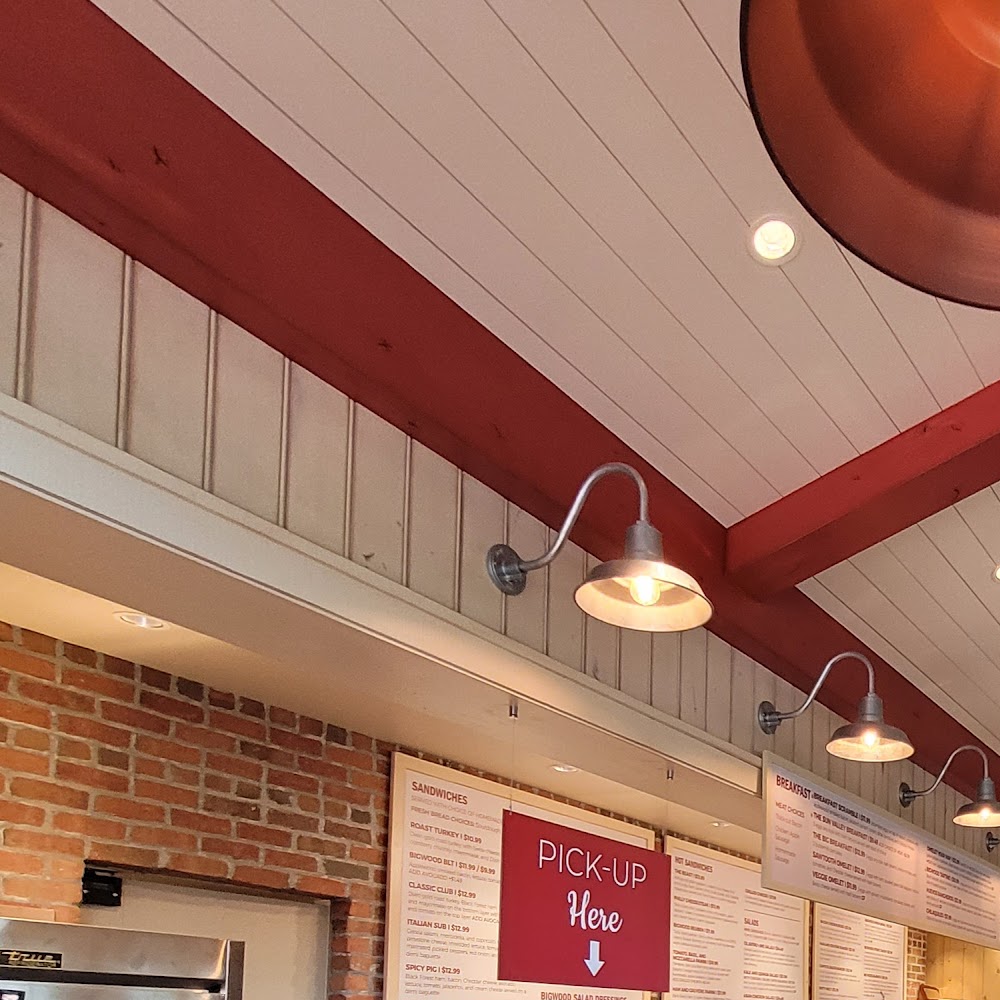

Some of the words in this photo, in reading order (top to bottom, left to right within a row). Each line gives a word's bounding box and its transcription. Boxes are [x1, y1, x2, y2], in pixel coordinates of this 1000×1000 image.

[412, 782, 467, 804] SANDWICHES
[777, 775, 811, 800] BREAKFAST
[814, 792, 838, 809] BREAKFAST
[411, 806, 429, 815] FRESH
[431, 811, 449, 820] BREAD
[410, 822, 433, 832] ROAST
[434, 827, 459, 838] TURKEY
[409, 852, 442, 863] BIGWOOD
[539, 839, 647, 889] PICK-UP
[685, 859, 712, 872] SANDWICHES
[409, 882, 436, 891] CLASSIC
[458, 890, 476, 898] $12.99
[568, 889, 623, 932] Here
[407, 919, 432, 928] ITALIAN
[541, 992, 571, 1000] BIGWOOD
